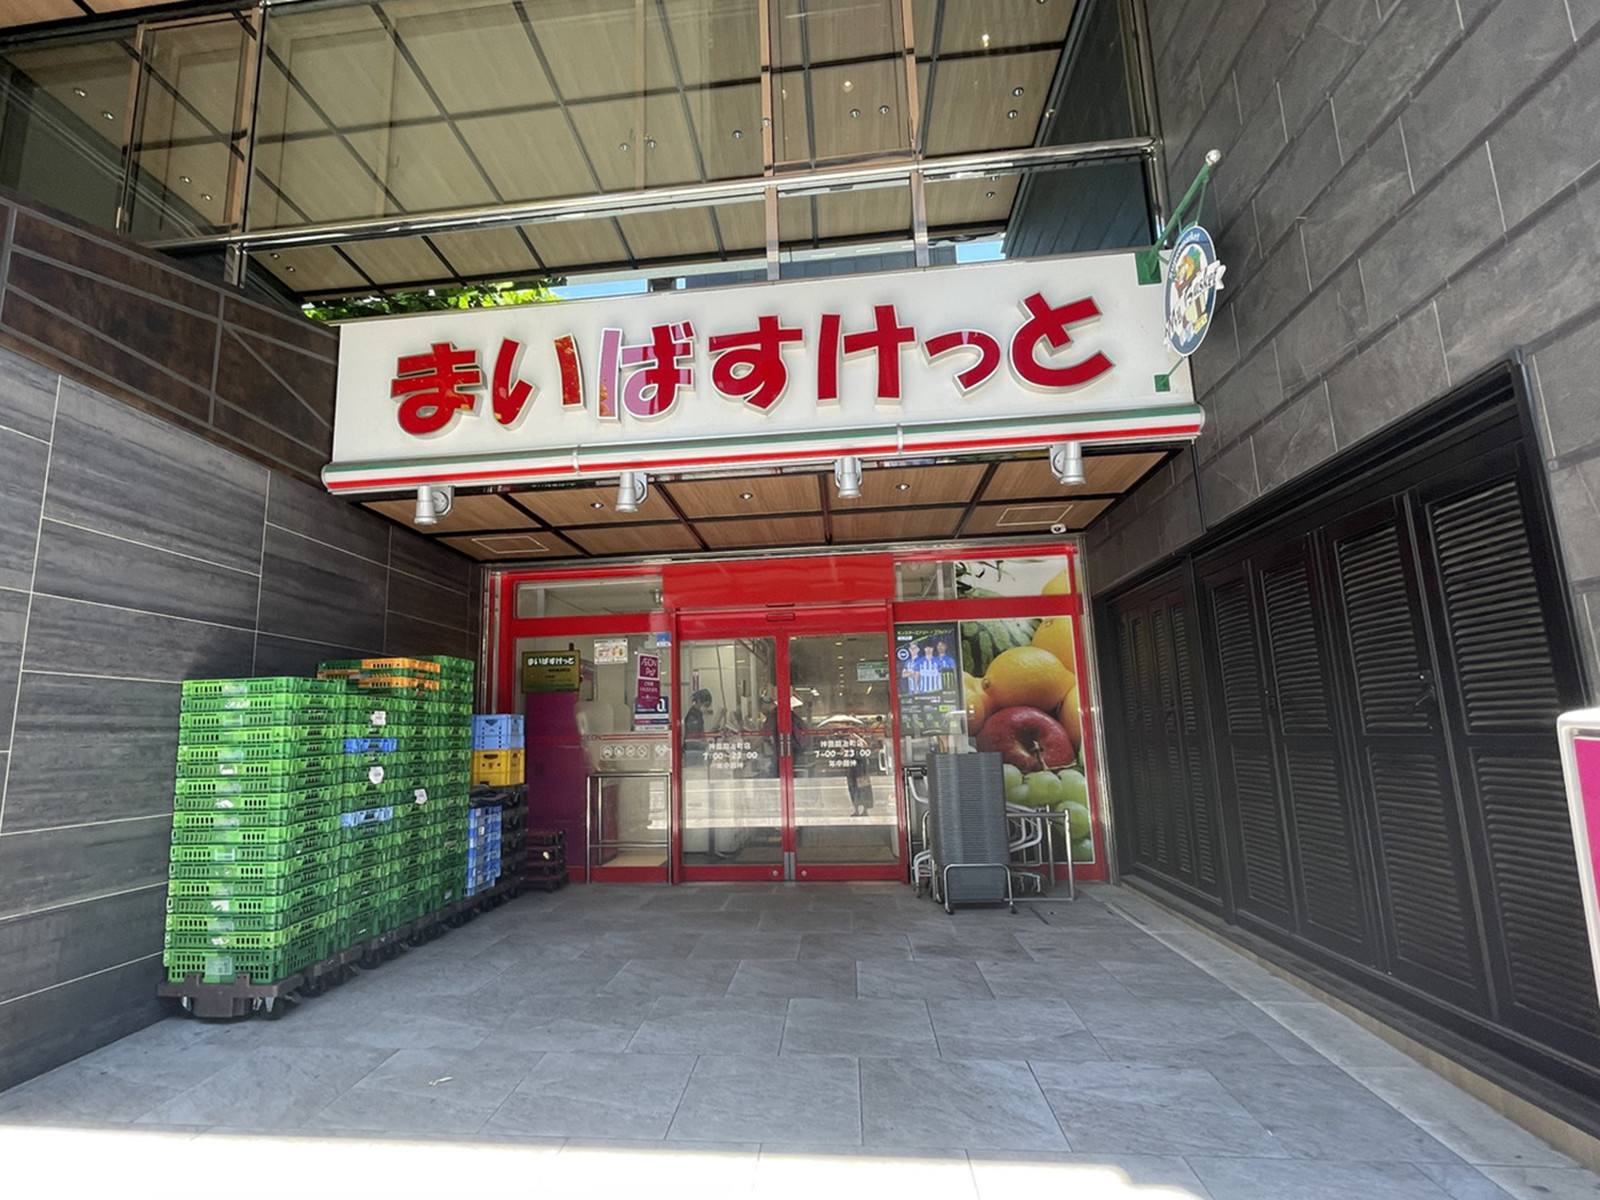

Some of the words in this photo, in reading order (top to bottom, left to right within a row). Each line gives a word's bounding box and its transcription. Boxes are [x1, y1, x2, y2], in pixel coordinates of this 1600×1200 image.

[392, 291, 1114, 436] まいばすけっと
